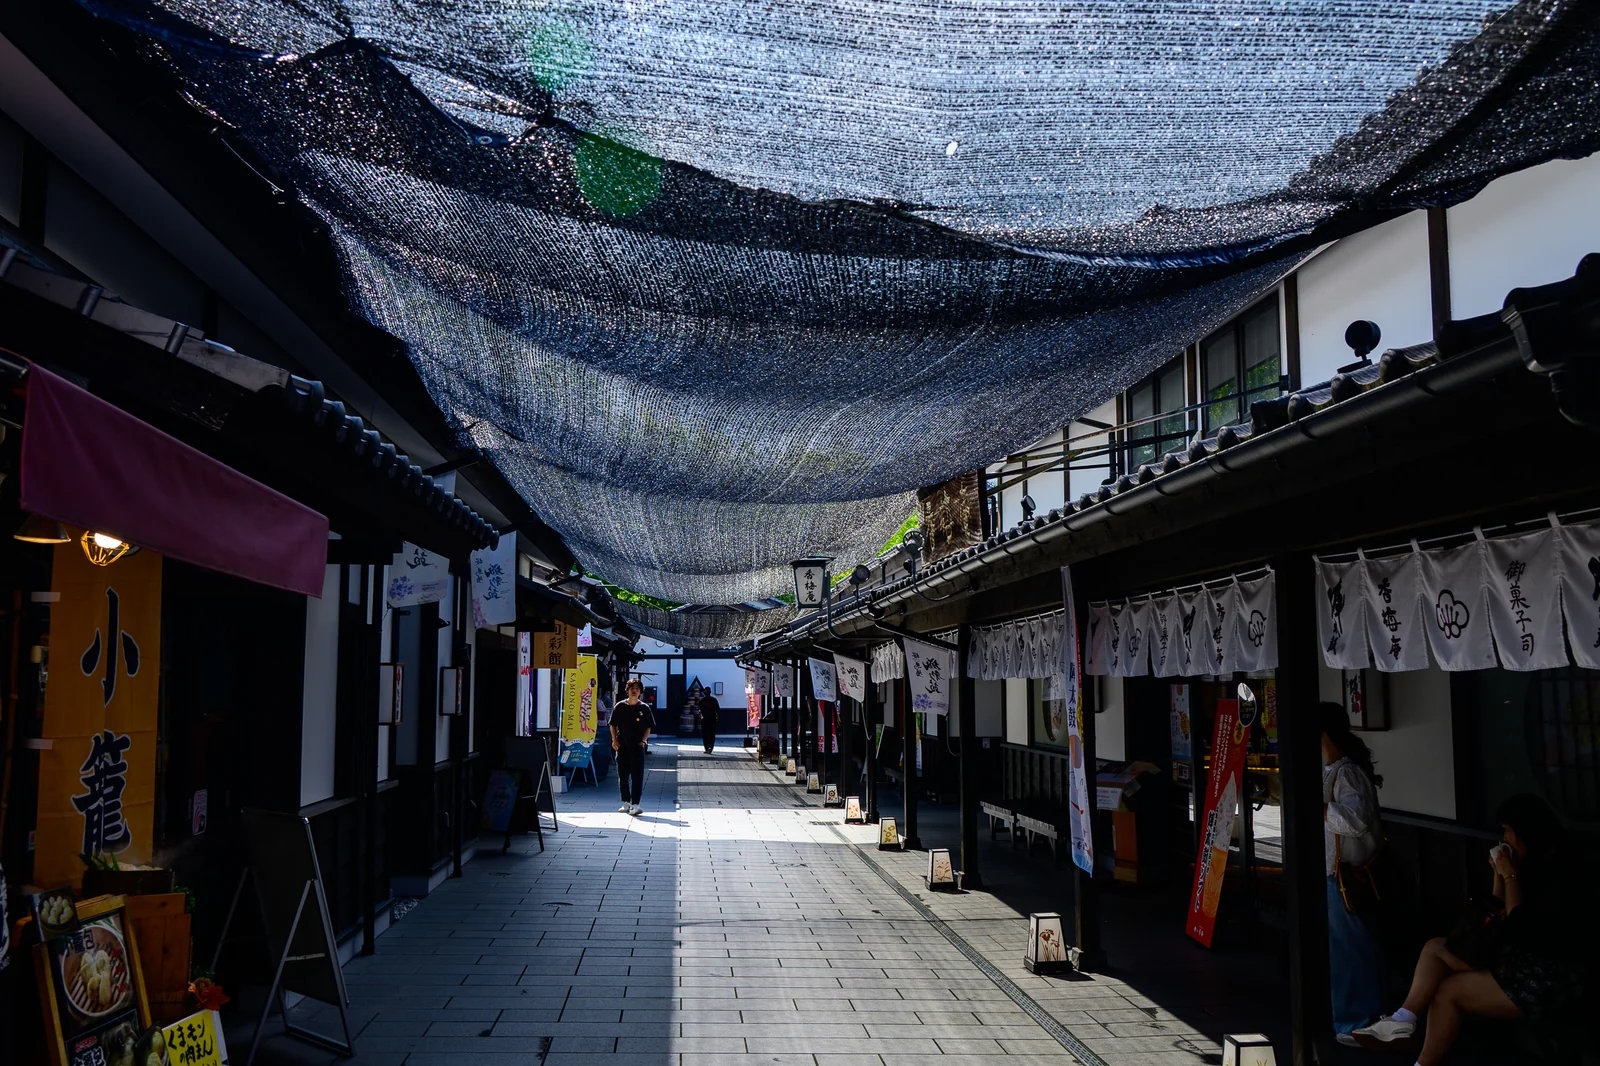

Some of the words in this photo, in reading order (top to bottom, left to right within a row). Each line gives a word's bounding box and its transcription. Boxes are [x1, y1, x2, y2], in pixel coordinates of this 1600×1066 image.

[1504, 559, 1535, 657] 御菓子司
[70, 585, 140, 860] 小籠
